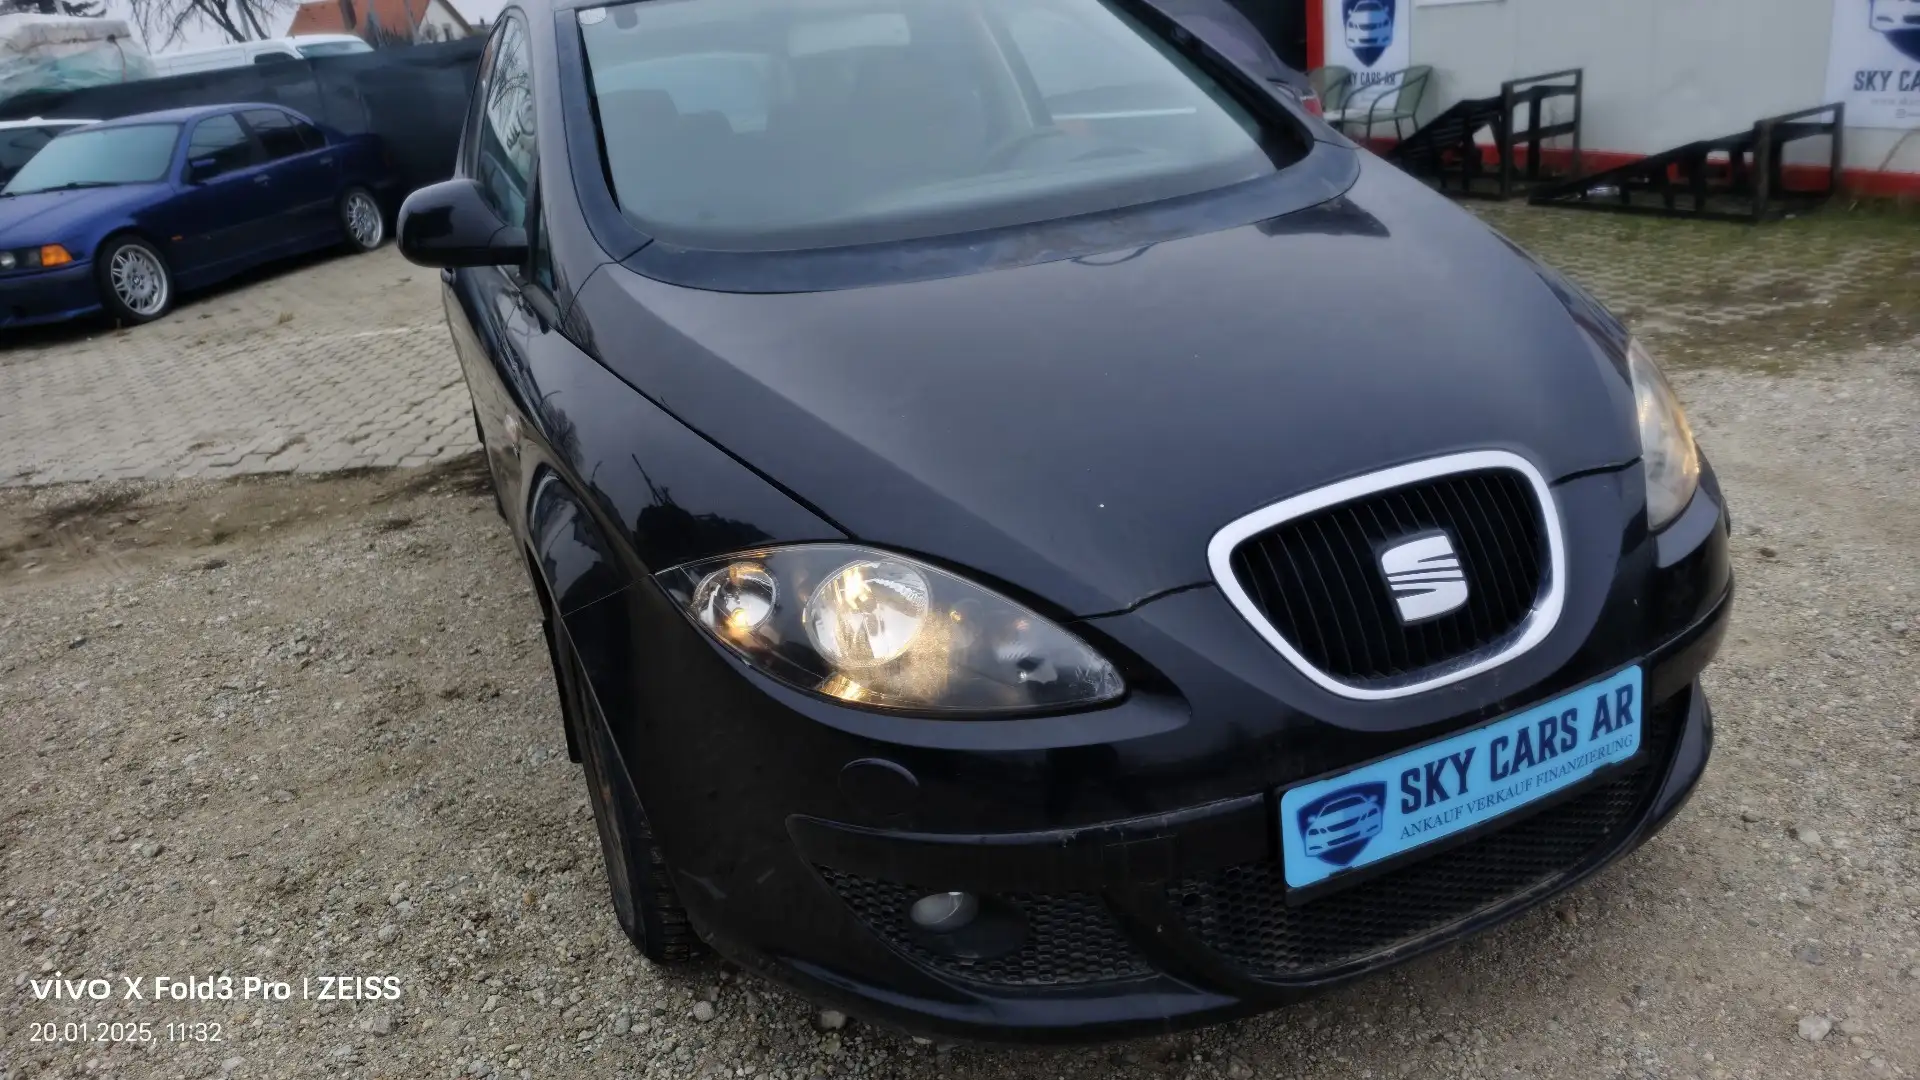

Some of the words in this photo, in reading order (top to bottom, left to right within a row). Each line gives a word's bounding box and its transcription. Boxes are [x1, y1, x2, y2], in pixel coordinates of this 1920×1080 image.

[1853, 70, 1893, 92] SKY
[1400, 805, 1464, 840] ANKAUF
[1465, 777, 1533, 815] VERKAUF
[1535, 734, 1634, 788] FINANZIERUNG
[1401, 747, 1476, 814] SKY
[1490, 707, 1578, 782] CARS
[1588, 683, 1634, 742] AR
